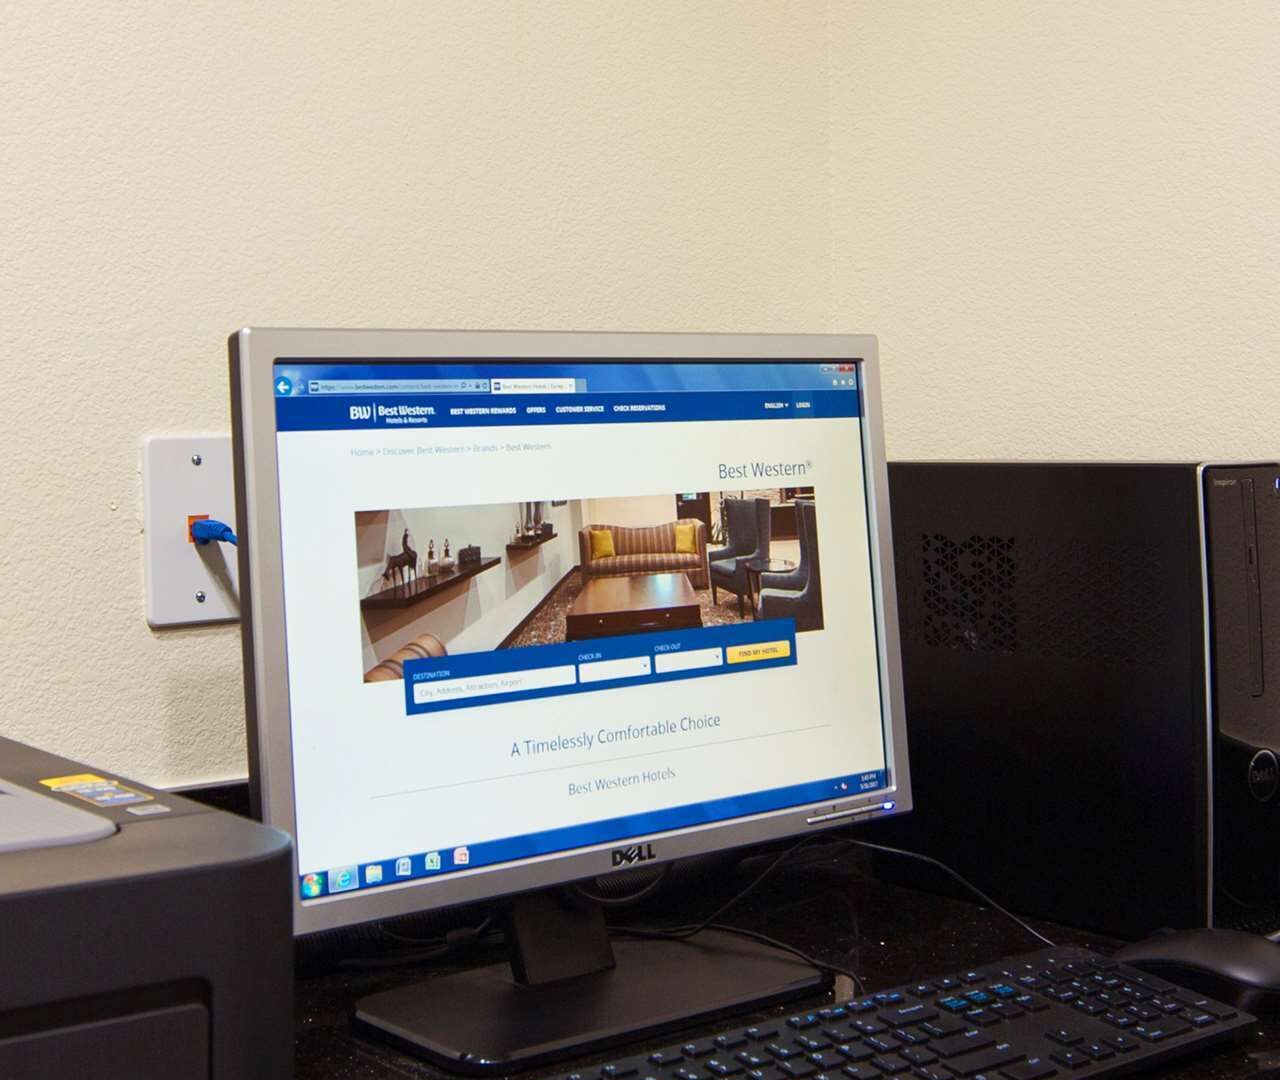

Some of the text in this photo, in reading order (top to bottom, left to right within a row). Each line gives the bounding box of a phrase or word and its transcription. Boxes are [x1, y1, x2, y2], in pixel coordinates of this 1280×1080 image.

[350, 405, 435, 419] BW Best Western
[464, 407, 489, 415] WESTERN
[526, 406, 546, 414] OFFERS
[718, 462, 747, 479] Best
[413, 670, 450, 680] DESTINATION
[510, 713, 721, 757] A Timelessly Comfortable Choice
[568, 767, 676, 796] Best Western Hotels
[611, 843, 657, 867] DELL
